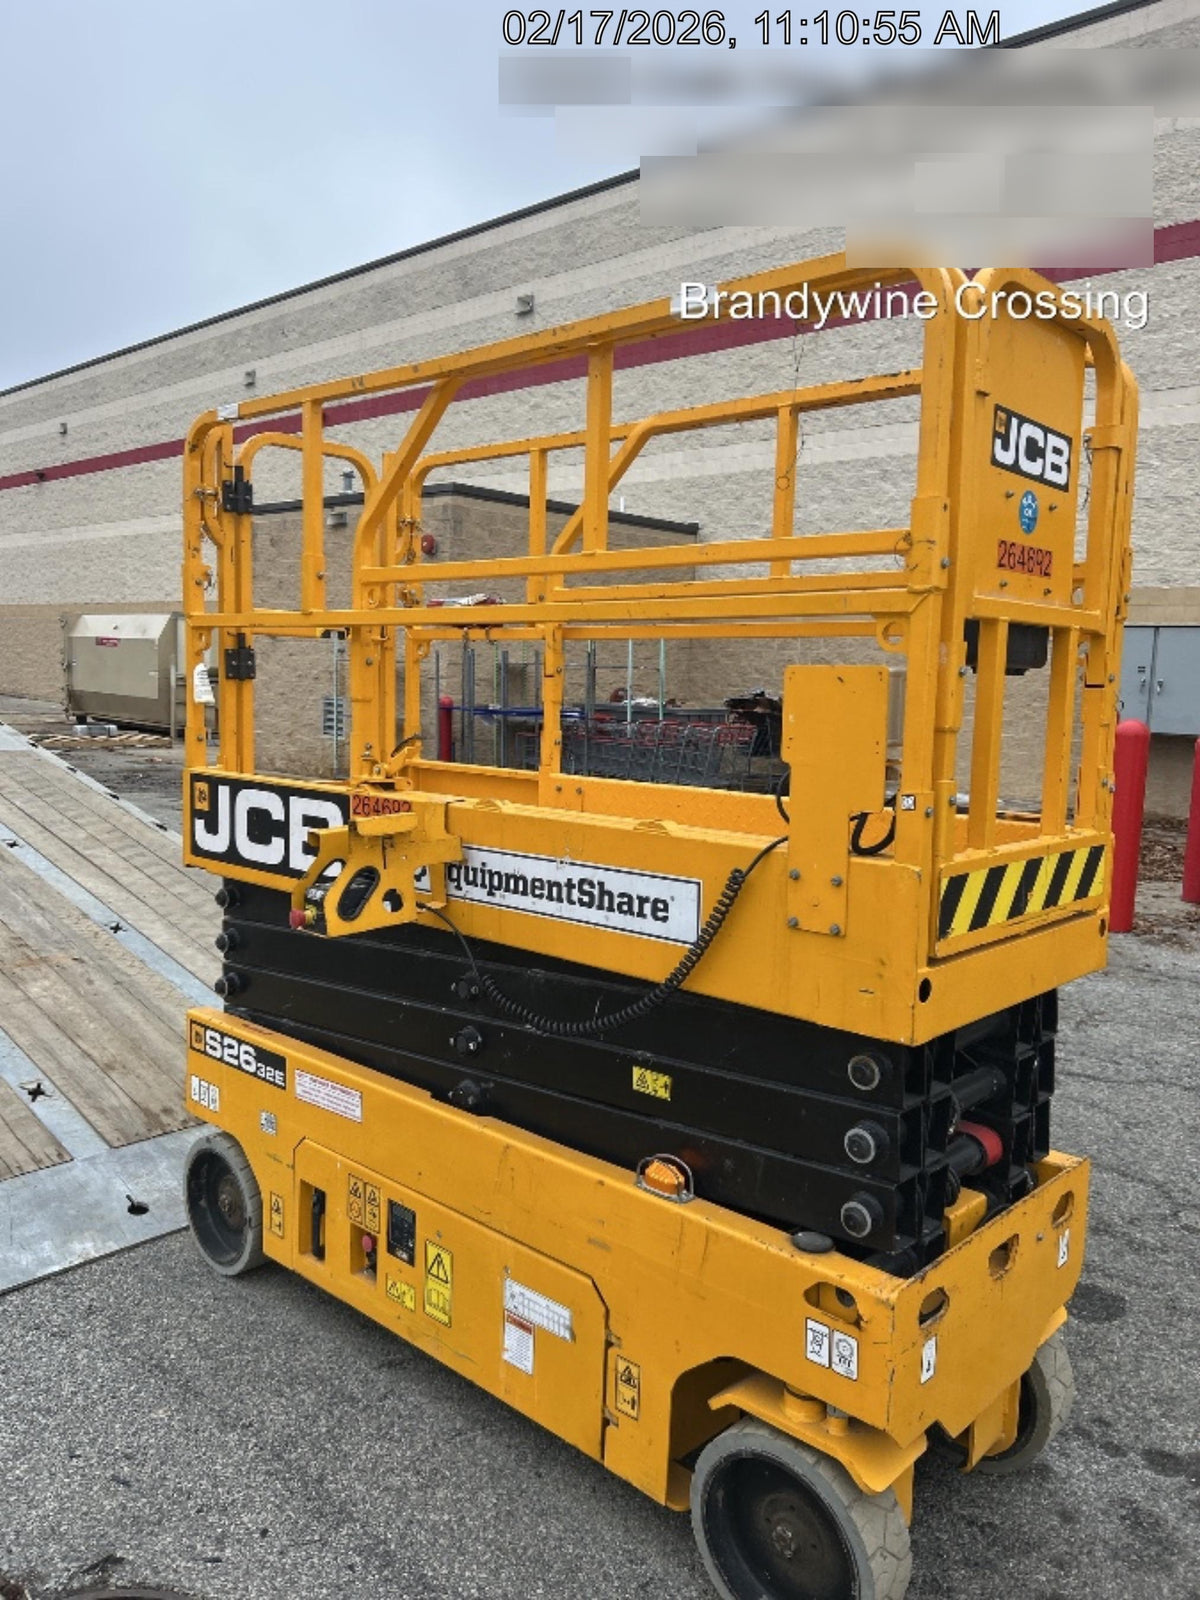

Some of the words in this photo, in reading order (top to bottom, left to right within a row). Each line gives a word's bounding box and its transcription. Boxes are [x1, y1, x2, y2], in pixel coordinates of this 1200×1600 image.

[994, 415, 1070, 486] JCB
[998, 540, 1053, 577] 264692
[413, 857, 670, 924] quipmentShare
